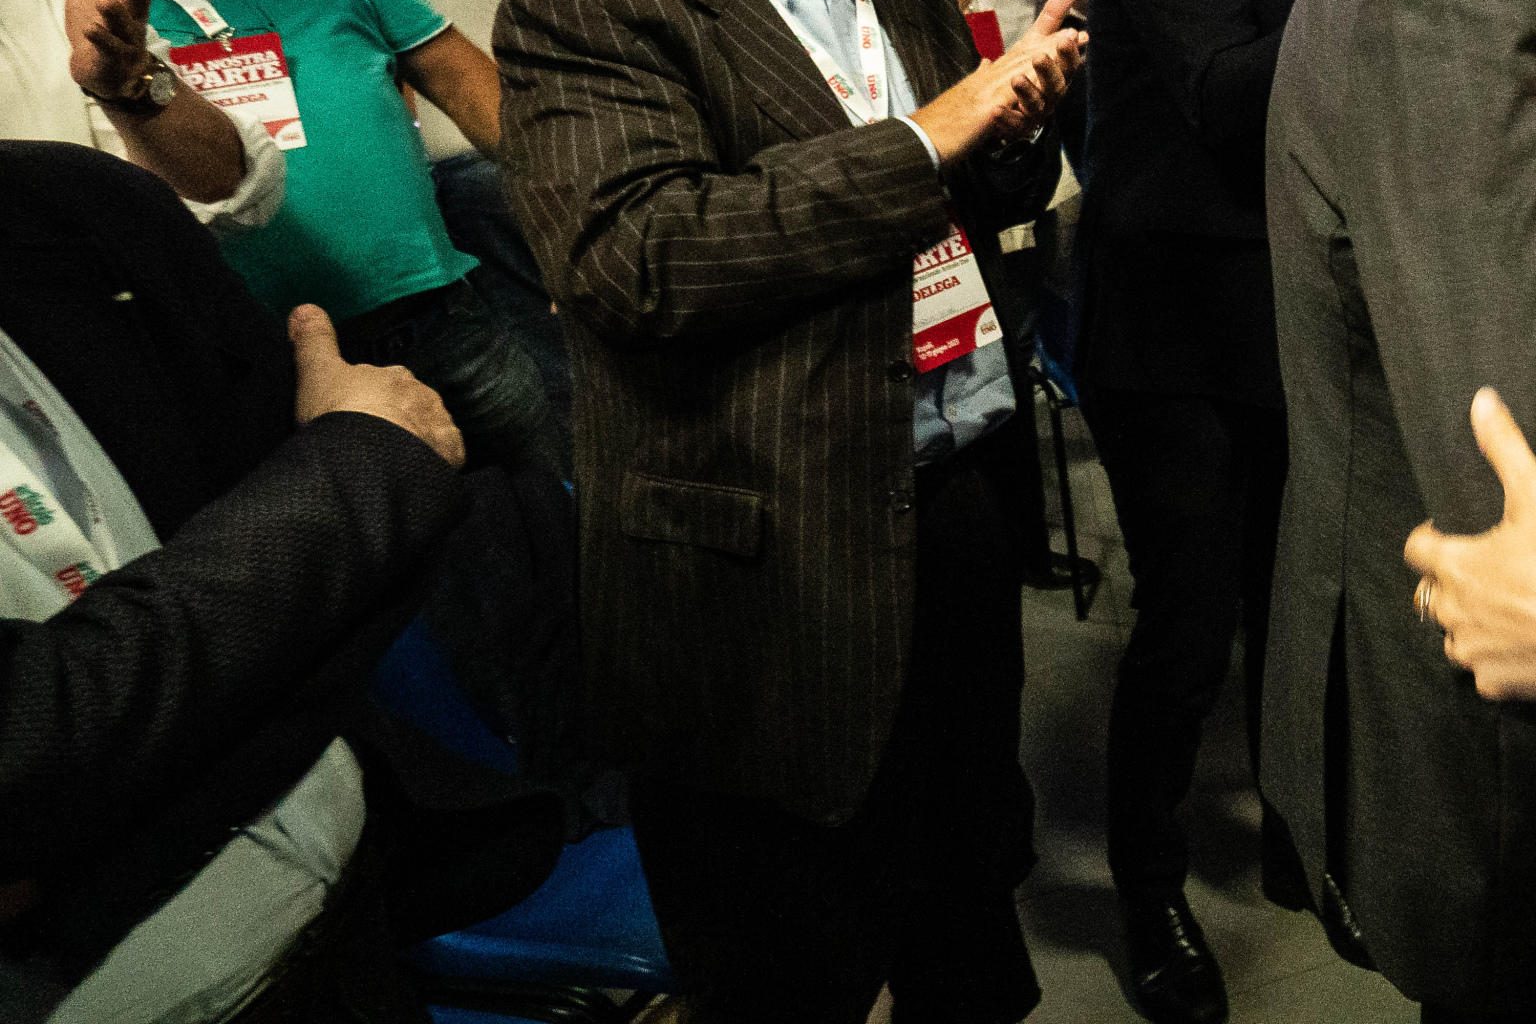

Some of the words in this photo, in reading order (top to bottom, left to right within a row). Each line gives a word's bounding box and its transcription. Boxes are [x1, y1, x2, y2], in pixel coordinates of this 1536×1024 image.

[861, 25, 872, 50] UNO
[207, 49, 280, 72] NOSTRA
[181, 60, 284, 91] PARTE
[866, 74, 878, 101] UNO
[0, 489, 39, 536] UNO
[55, 564, 88, 604] UN
